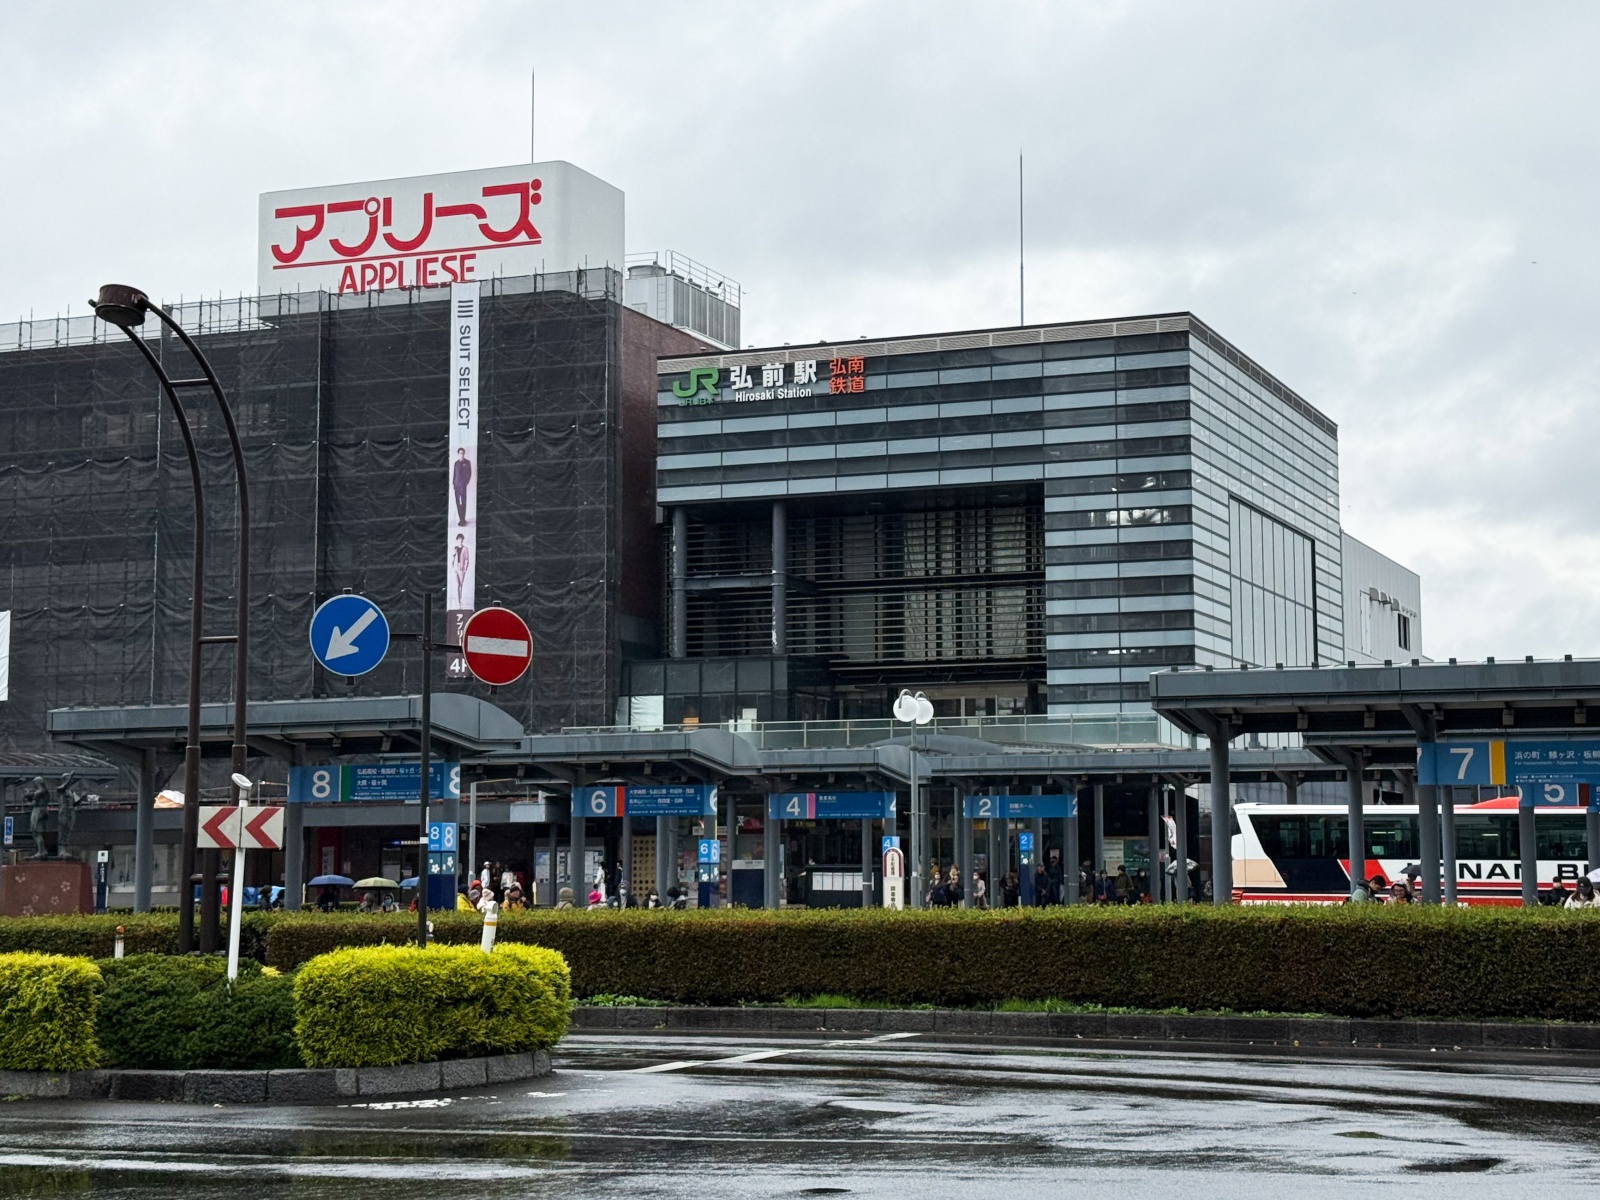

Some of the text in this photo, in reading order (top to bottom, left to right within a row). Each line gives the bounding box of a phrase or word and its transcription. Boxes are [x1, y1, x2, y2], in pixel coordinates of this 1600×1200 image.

[271, 178, 543, 263] アプリーズ
[338, 253, 477, 297] APPLIESE
[458, 324, 472, 430] SUIT SELECT
[672, 367, 720, 397] JR
[729, 359, 818, 391] 弘前駅
[735, 387, 812, 403] Hirosaki Station
[1450, 747, 1474, 780] 7
[312, 770, 331, 799] 8
[1544, 784, 1565, 803] 5
[590, 790, 607, 814] 6
[786, 796, 801, 816] 4
[979, 798, 992, 816] 2
[430, 826, 440, 840] 8
[444, 826, 454, 848] 8
[884, 839, 891, 848] 4
[1021, 835, 1028, 845] 2
[700, 843, 709, 855] 6
